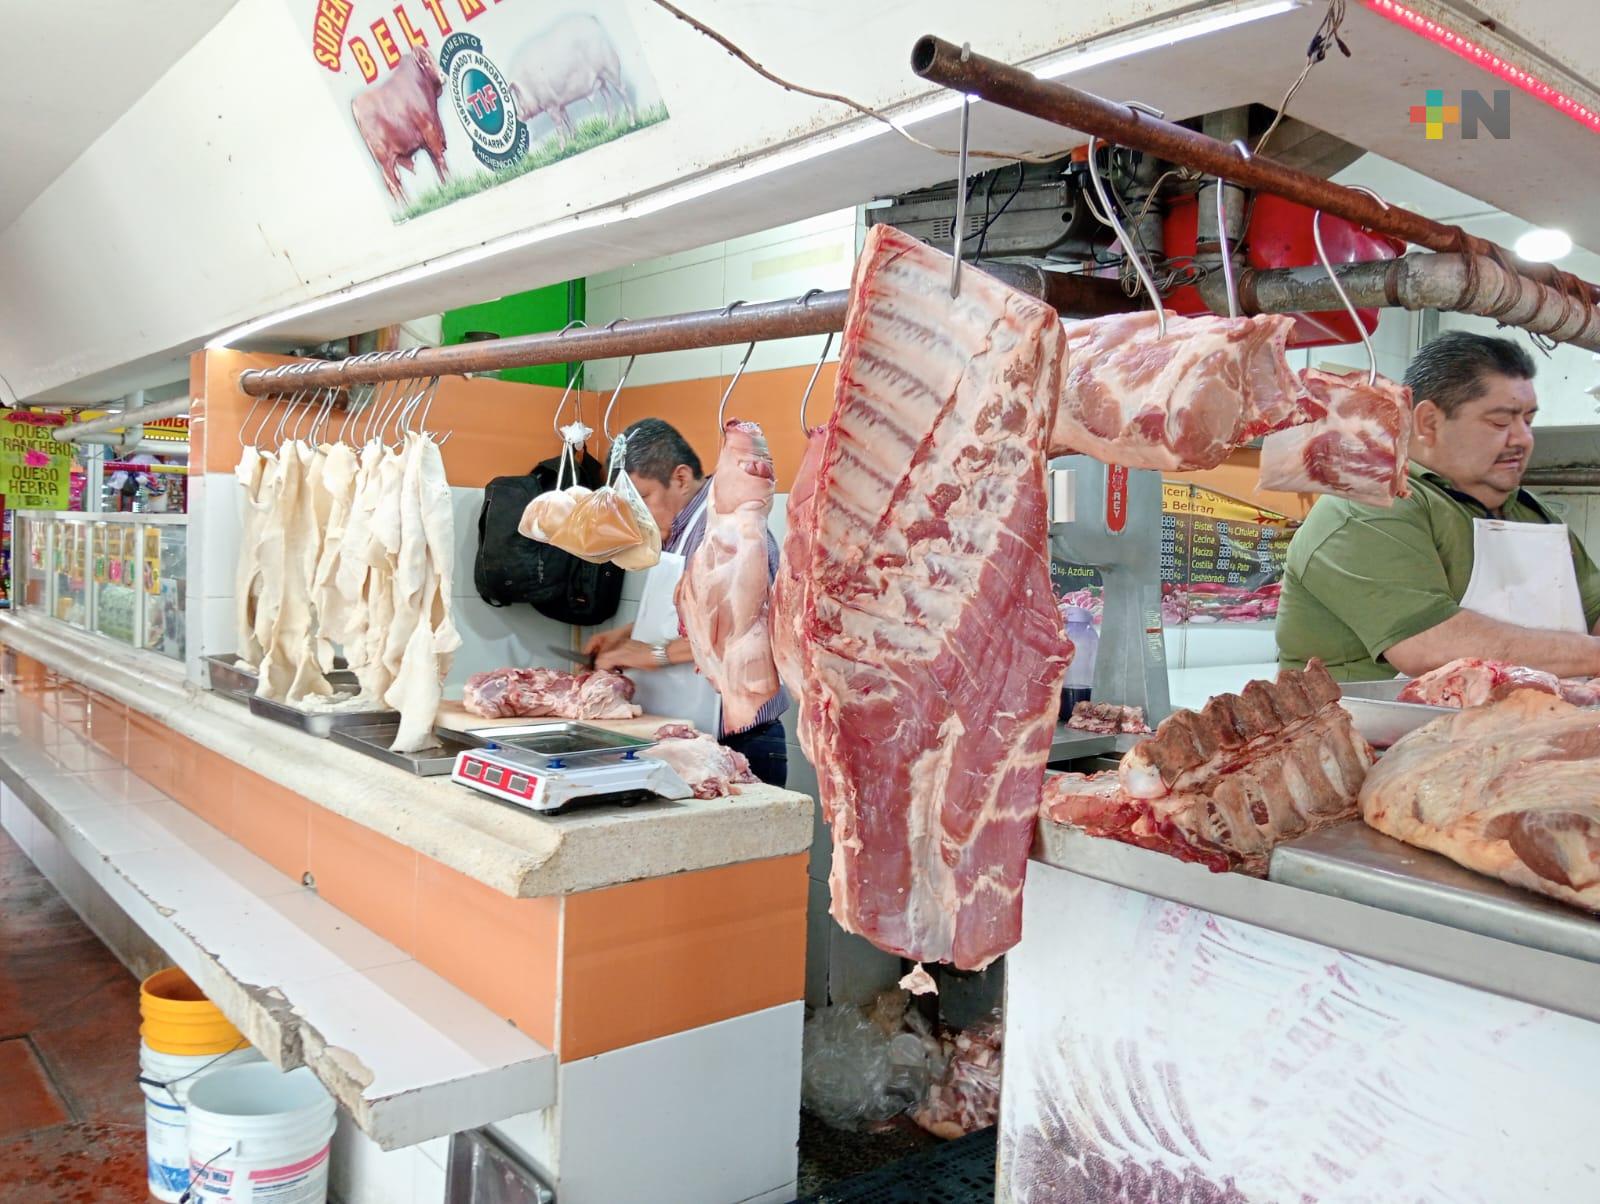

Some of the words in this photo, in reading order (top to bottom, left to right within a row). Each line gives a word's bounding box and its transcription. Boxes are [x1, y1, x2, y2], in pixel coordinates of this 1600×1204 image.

[348, 0, 508, 85] BELT
[441, 34, 478, 67] ALIMENTO
[475, 55, 510, 103] APROBADO
[12, 465, 60, 482] QUESO
[8, 480, 59, 496] HEBRA
[1113, 491, 1121, 519] REY
[1172, 501, 1215, 514] Beltran
